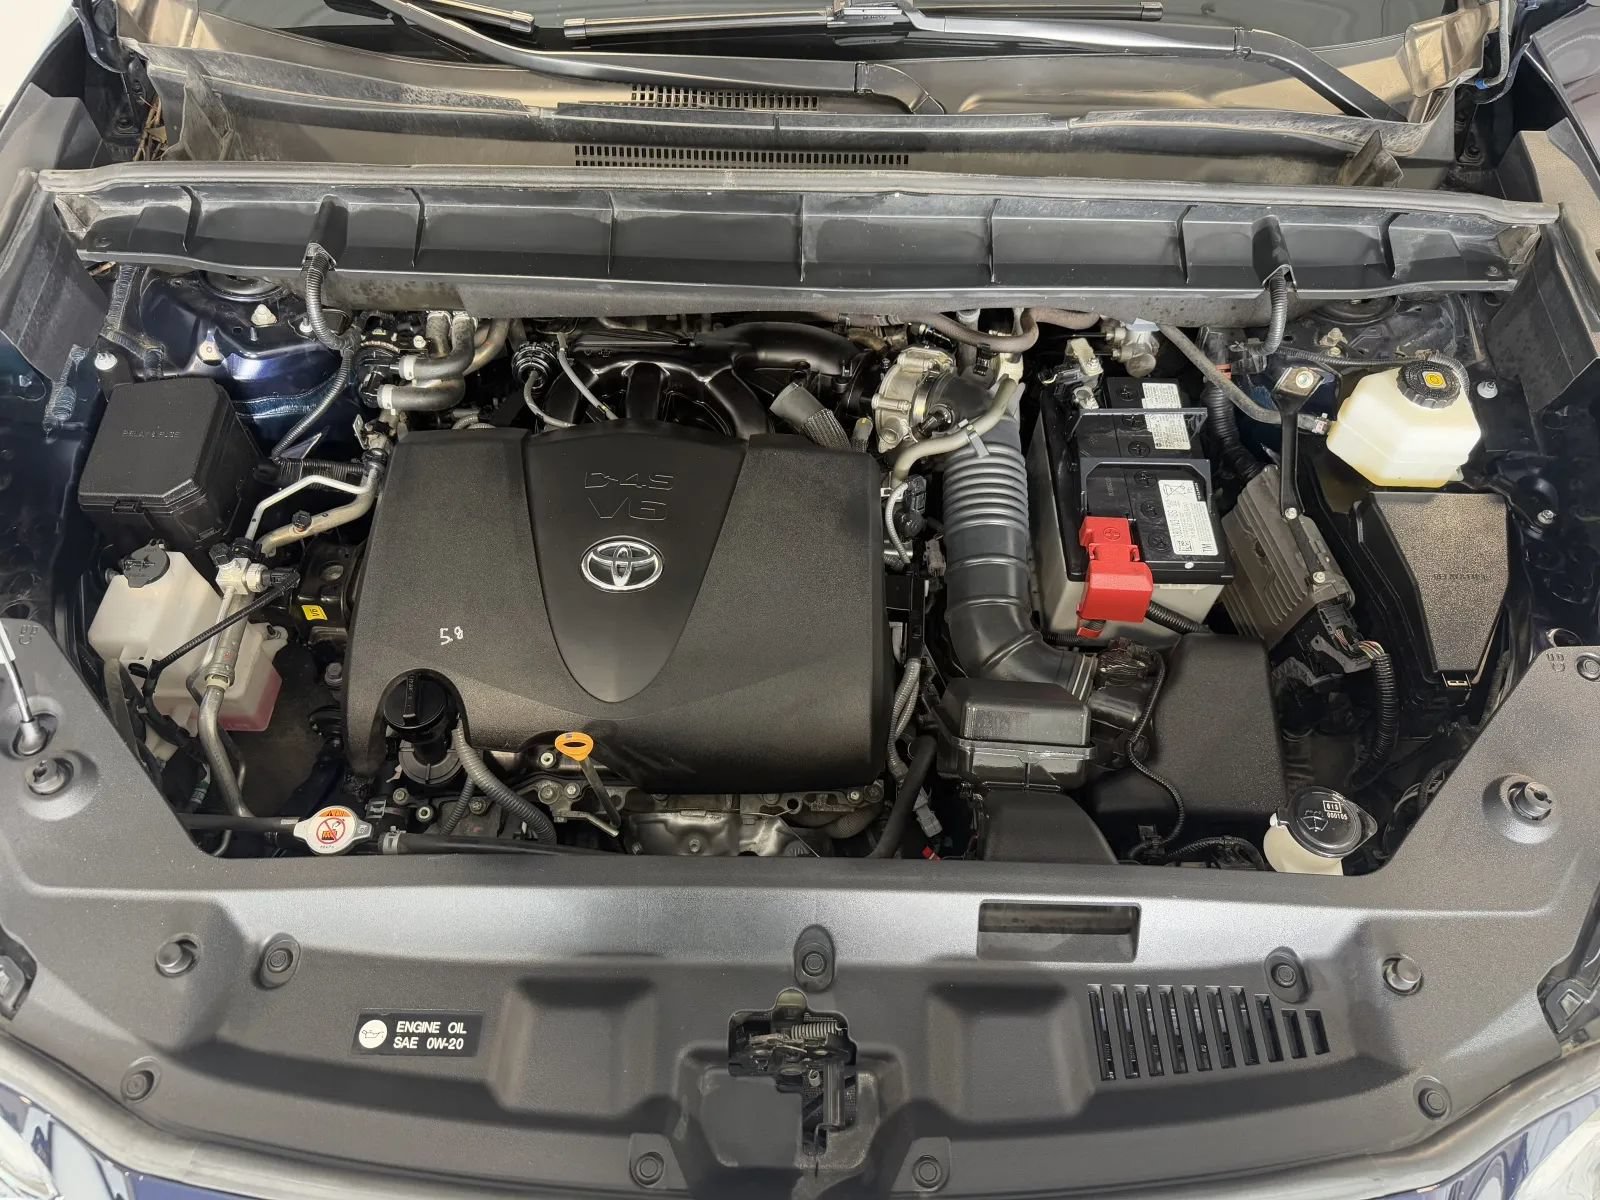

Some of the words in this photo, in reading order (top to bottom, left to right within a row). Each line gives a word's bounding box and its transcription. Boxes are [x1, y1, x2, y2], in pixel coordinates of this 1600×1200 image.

[586, 496, 668, 521] V6
[396, 1021, 442, 1034] ENGINE
[447, 1022, 467, 1034] OIL
[393, 1036, 419, 1049] SAE
[426, 1037, 464, 1050] 0W-20
